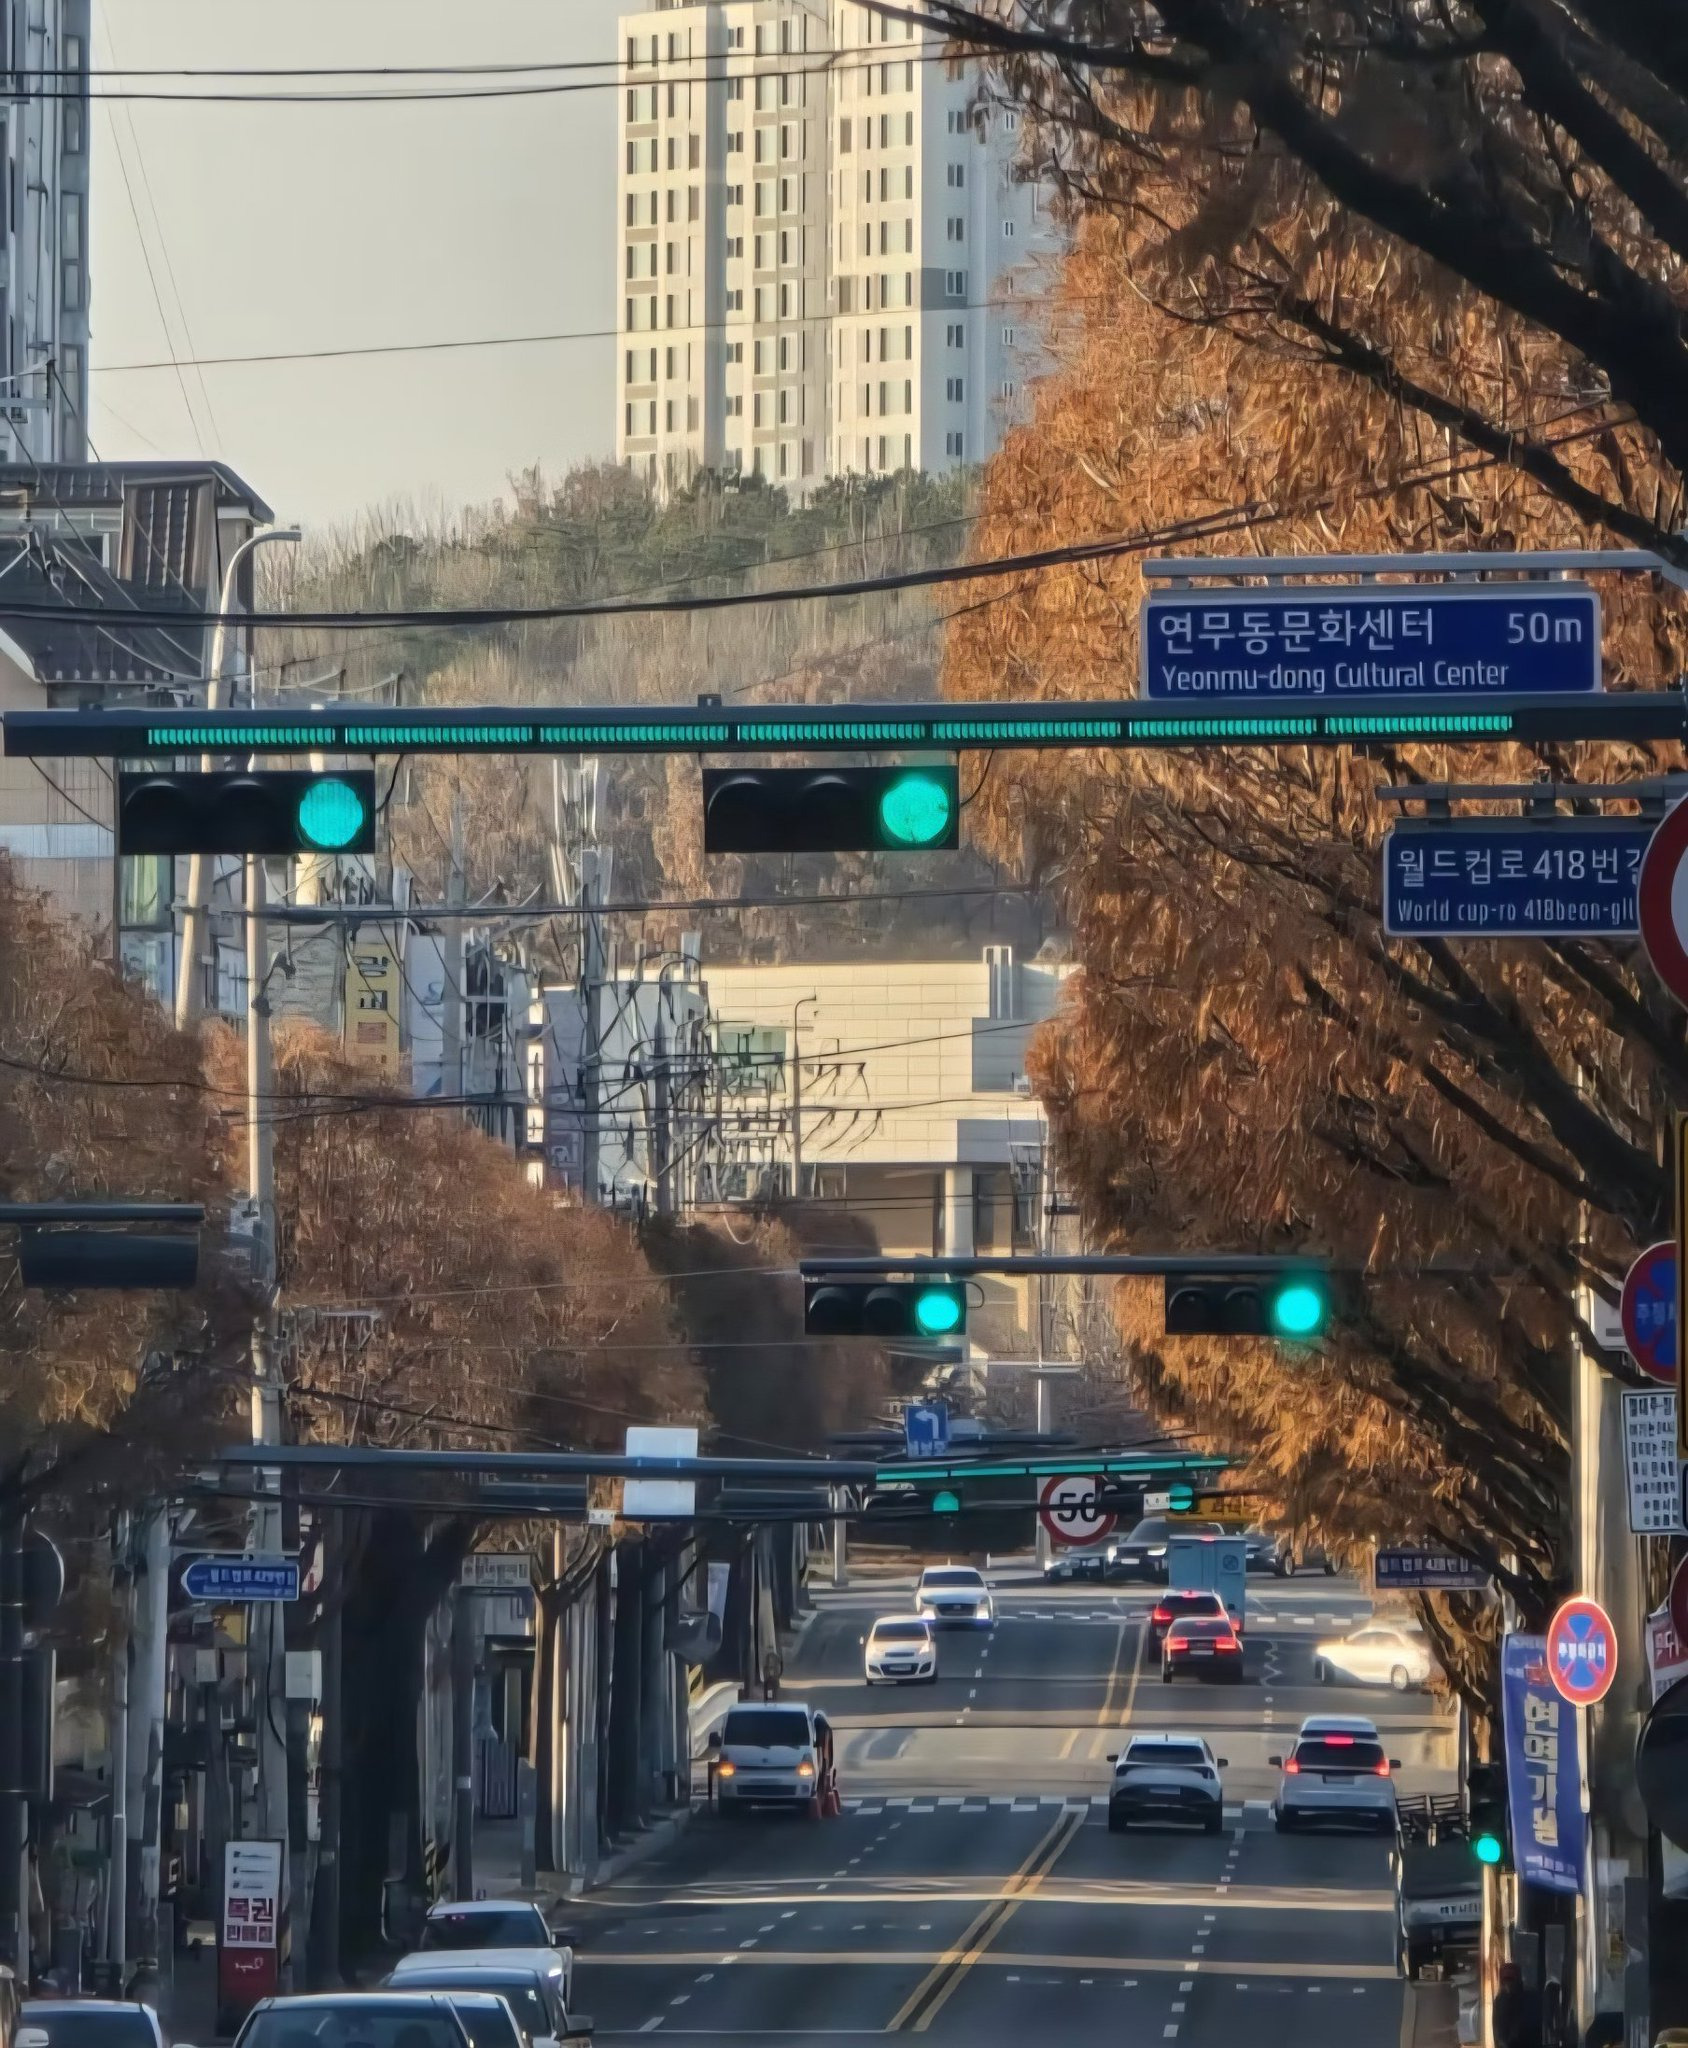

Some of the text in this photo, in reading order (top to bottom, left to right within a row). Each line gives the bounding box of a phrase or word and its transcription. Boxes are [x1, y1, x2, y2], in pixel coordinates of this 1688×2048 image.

[1160, 608, 1582, 654] 연무동문화센터 50m
[1161, 660, 1510, 693] Yeonmu-dong Cultural Center
[1398, 899, 1449, 921] World
[1458, 902, 1517, 924] cup-ro
